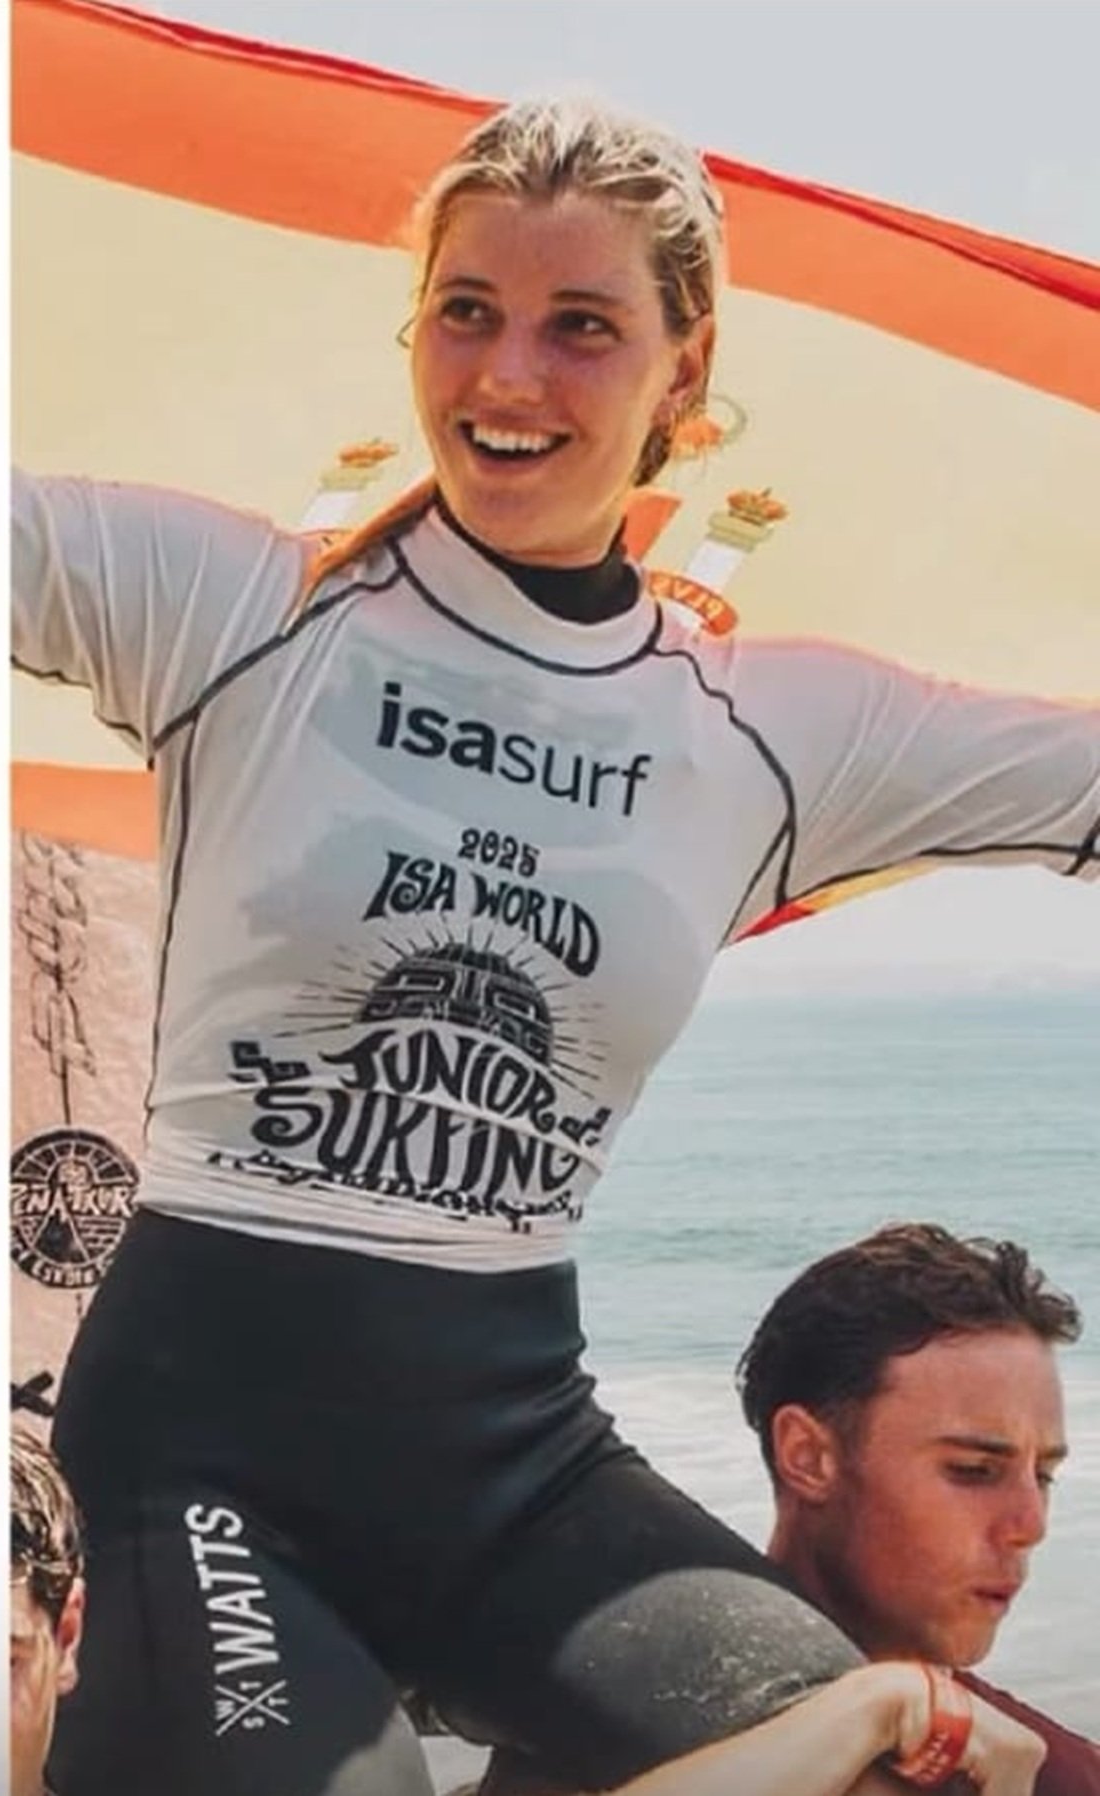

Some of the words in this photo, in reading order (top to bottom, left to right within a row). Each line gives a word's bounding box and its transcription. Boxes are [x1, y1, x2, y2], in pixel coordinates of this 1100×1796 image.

[376, 681, 652, 817] isasurf
[362, 851, 458, 922] ISA
[471, 871, 600, 978] WORLD
[458, 828, 541, 878] 2025
[318, 1028, 556, 1135] JUNIOR
[184, 1503, 280, 1675] WATTS
